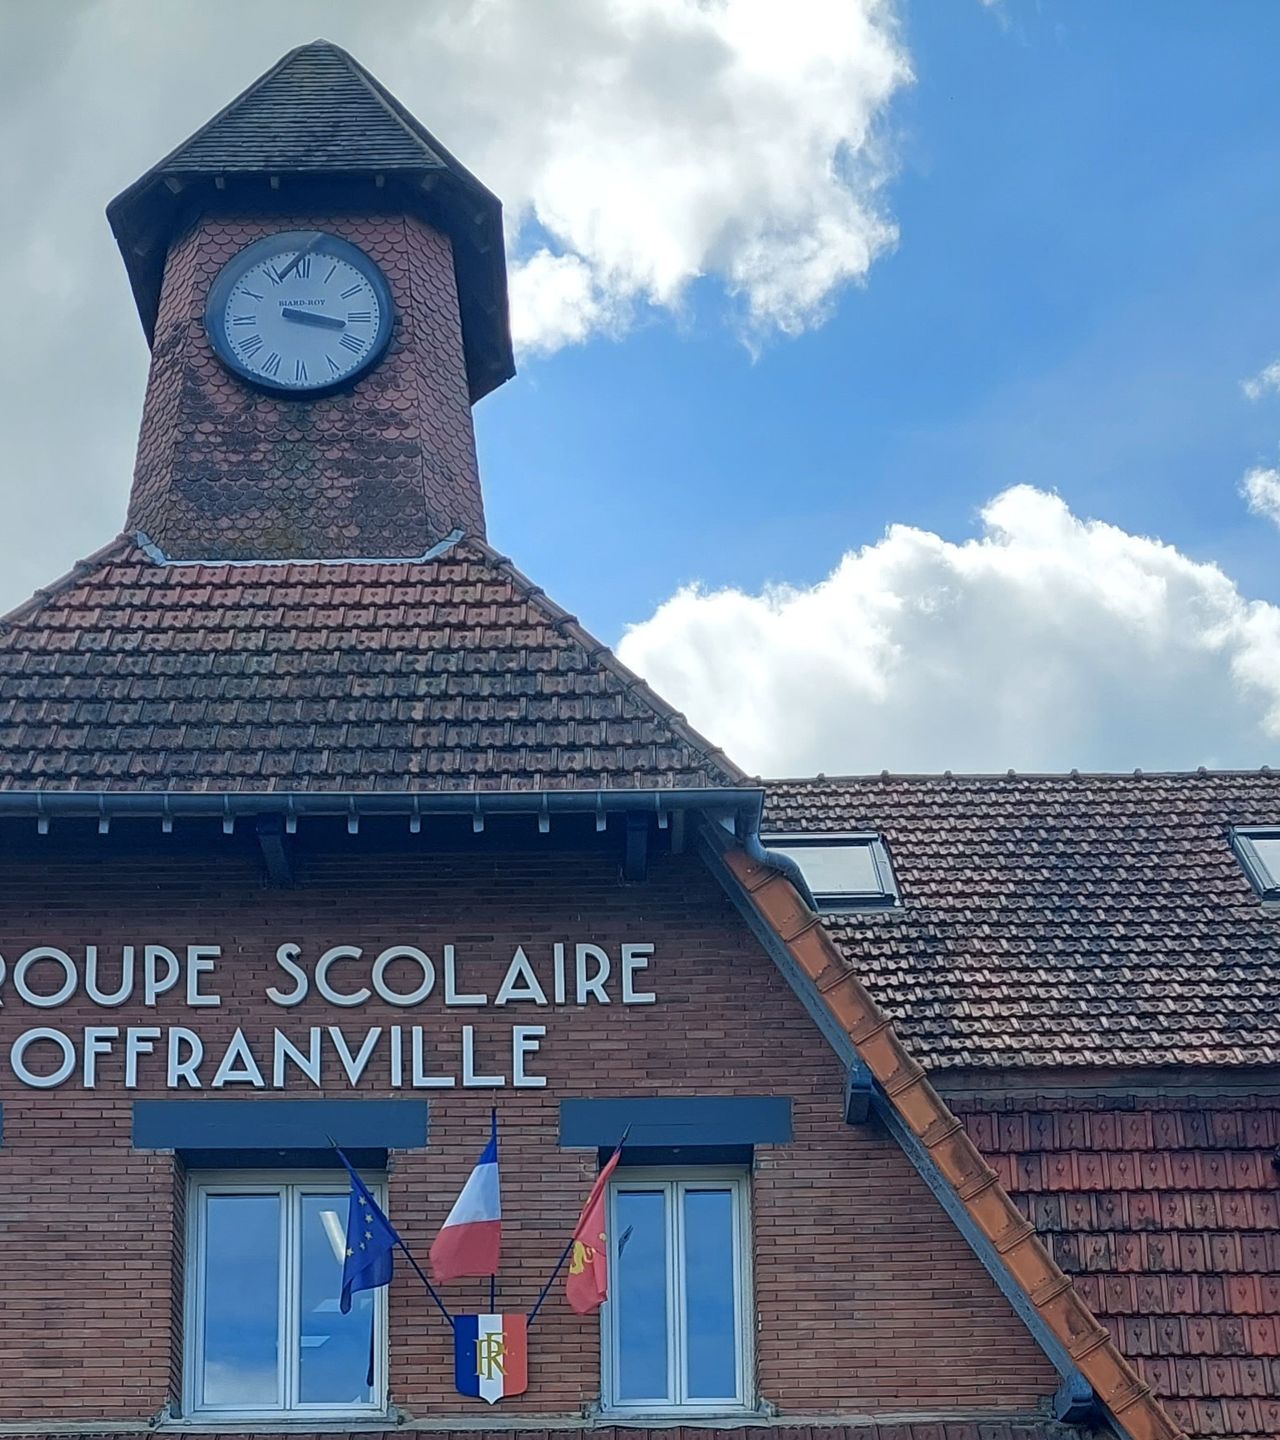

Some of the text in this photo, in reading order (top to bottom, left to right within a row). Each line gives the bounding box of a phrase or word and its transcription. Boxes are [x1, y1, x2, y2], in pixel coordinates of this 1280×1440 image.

[241, 288, 264, 302] X
[340, 284, 363, 300] II
[278, 299, 326, 307] BIARD-ROY
[347, 311, 371, 323] III
[265, 942, 657, 1006] SCOLAIRE
[10, 1025, 548, 1089] OFFRANVILLE
